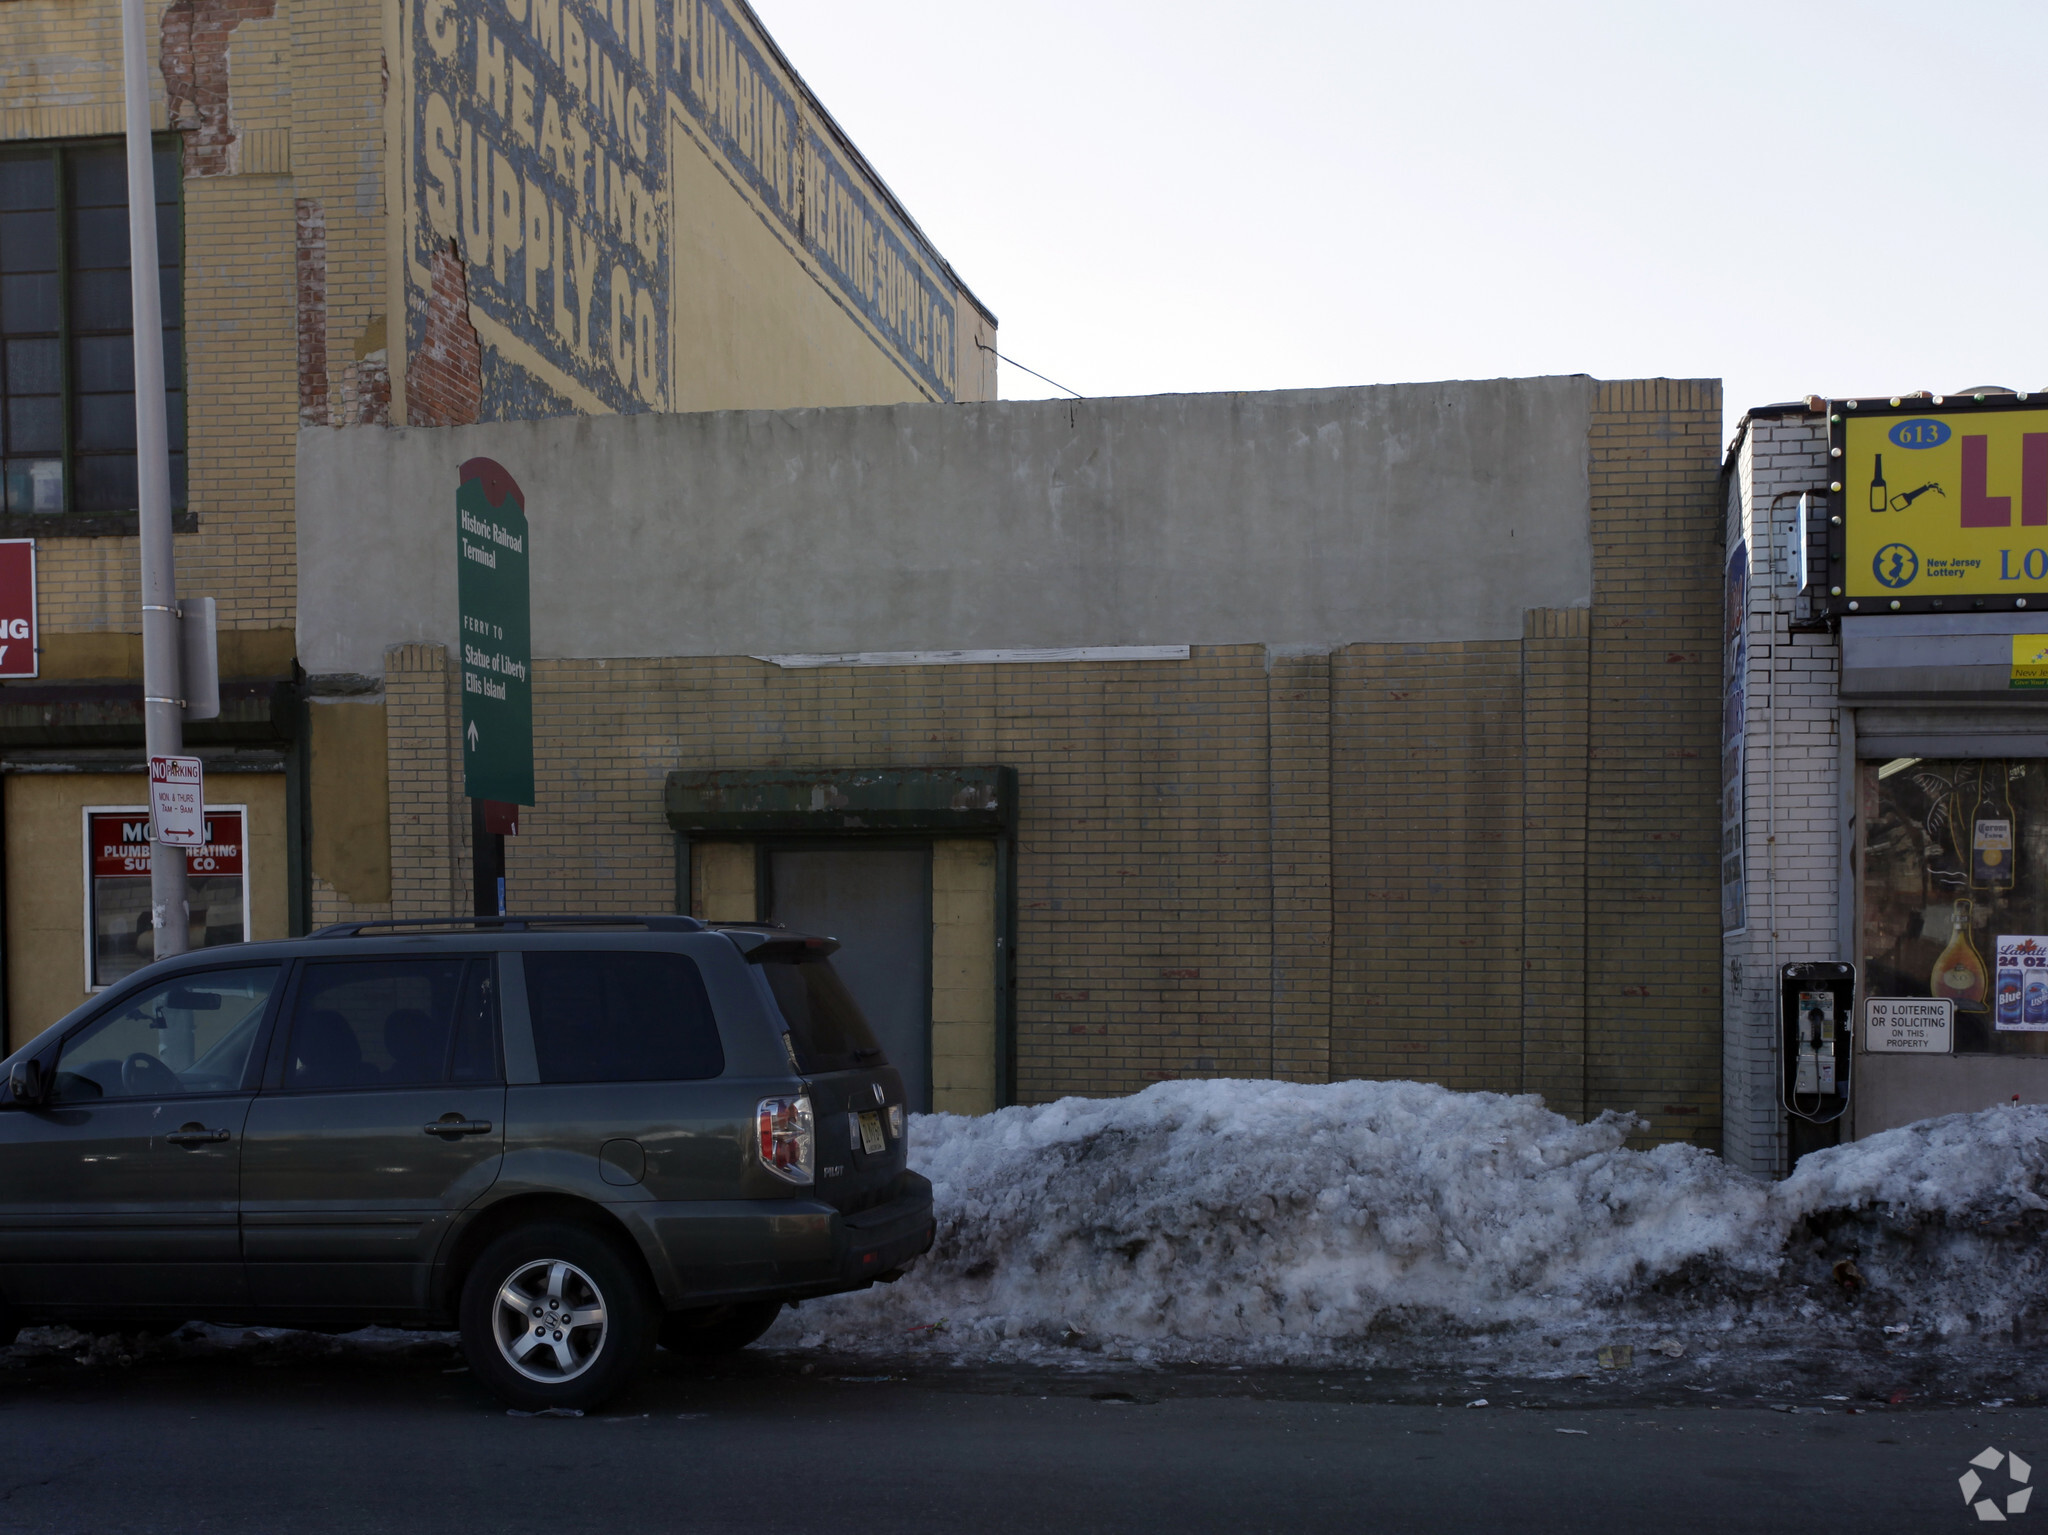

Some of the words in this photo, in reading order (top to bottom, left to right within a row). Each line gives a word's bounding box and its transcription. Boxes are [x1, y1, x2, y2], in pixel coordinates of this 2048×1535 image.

[474, 15, 659, 270] HEATING
[424, 92, 597, 357] SUPPLY
[804, 138, 876, 303] HEATING
[877, 226, 931, 366] SUPPLY
[1899, 424, 1939, 444] 613
[461, 508, 491, 540] Historic
[492, 522, 523, 554] Railroad
[462, 536, 496, 569] Terminal
[1927, 558, 1947, 567] New
[1950, 557, 1981, 569] Jersey
[1926, 567, 1965, 578] Lottery
[464, 615, 489, 636] FERRY
[493, 624, 503, 640] TO
[465, 643, 490, 669] Statue
[491, 652, 500, 672] of
[501, 654, 526, 683] Liberty
[465, 671, 483, 695] Ellis
[483, 676, 506, 701] Island
[152, 761, 166, 779] NO
[167, 764, 198, 778] PARKING
[162, 803, 172, 813] 7AM
[180, 804, 193, 814] 9AM
[192, 857, 220, 871] CO.
[1998, 943, 2048, 956] Labatt
[1998, 956, 2018, 967] 24
[1998, 990, 2022, 1005] Blue
[1873, 1004, 1888, 1015] NO
[1892, 1005, 1944, 1016] LOITERING
[1871, 1016, 1886, 1027] OR
[1891, 1017, 1945, 1028] SOLICITING
[1892, 1029, 1903, 1037] ON
[1907, 1029, 1925, 1038] THIS
[1886, 1039, 1929, 1048] PROPERTY
